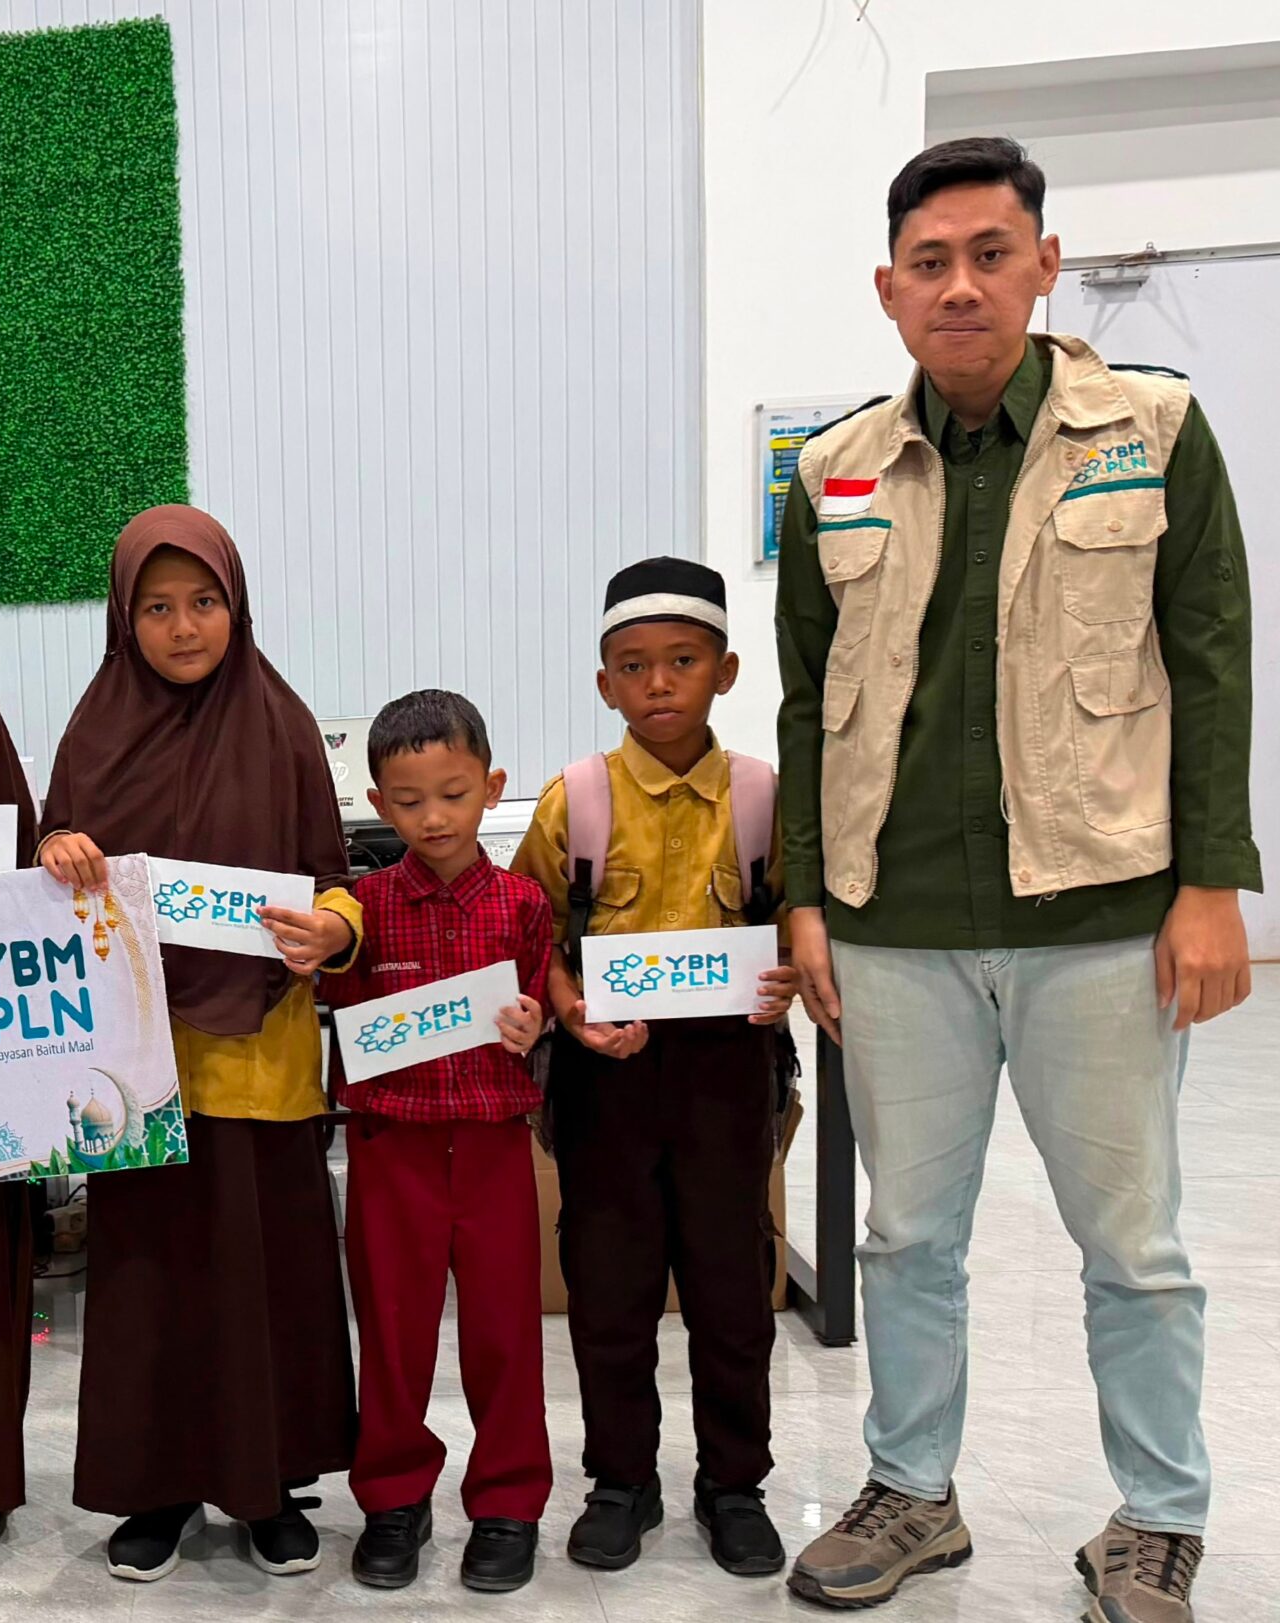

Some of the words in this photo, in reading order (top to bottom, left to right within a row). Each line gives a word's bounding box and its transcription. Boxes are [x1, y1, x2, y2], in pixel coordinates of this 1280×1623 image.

[1100, 440, 1145, 458] YBM
[1106, 456, 1147, 473] PLN
[210, 888, 267, 908] YBM
[211, 905, 264, 924] PLN
[665, 952, 728, 970] YBM
[670, 969, 729, 987] PLN
[411, 996, 470, 1022] YBM
[418, 1010, 473, 1036] PLN
[36, 1042, 66, 1057] Baitul
[68, 1038, 95, 1053] Maal
